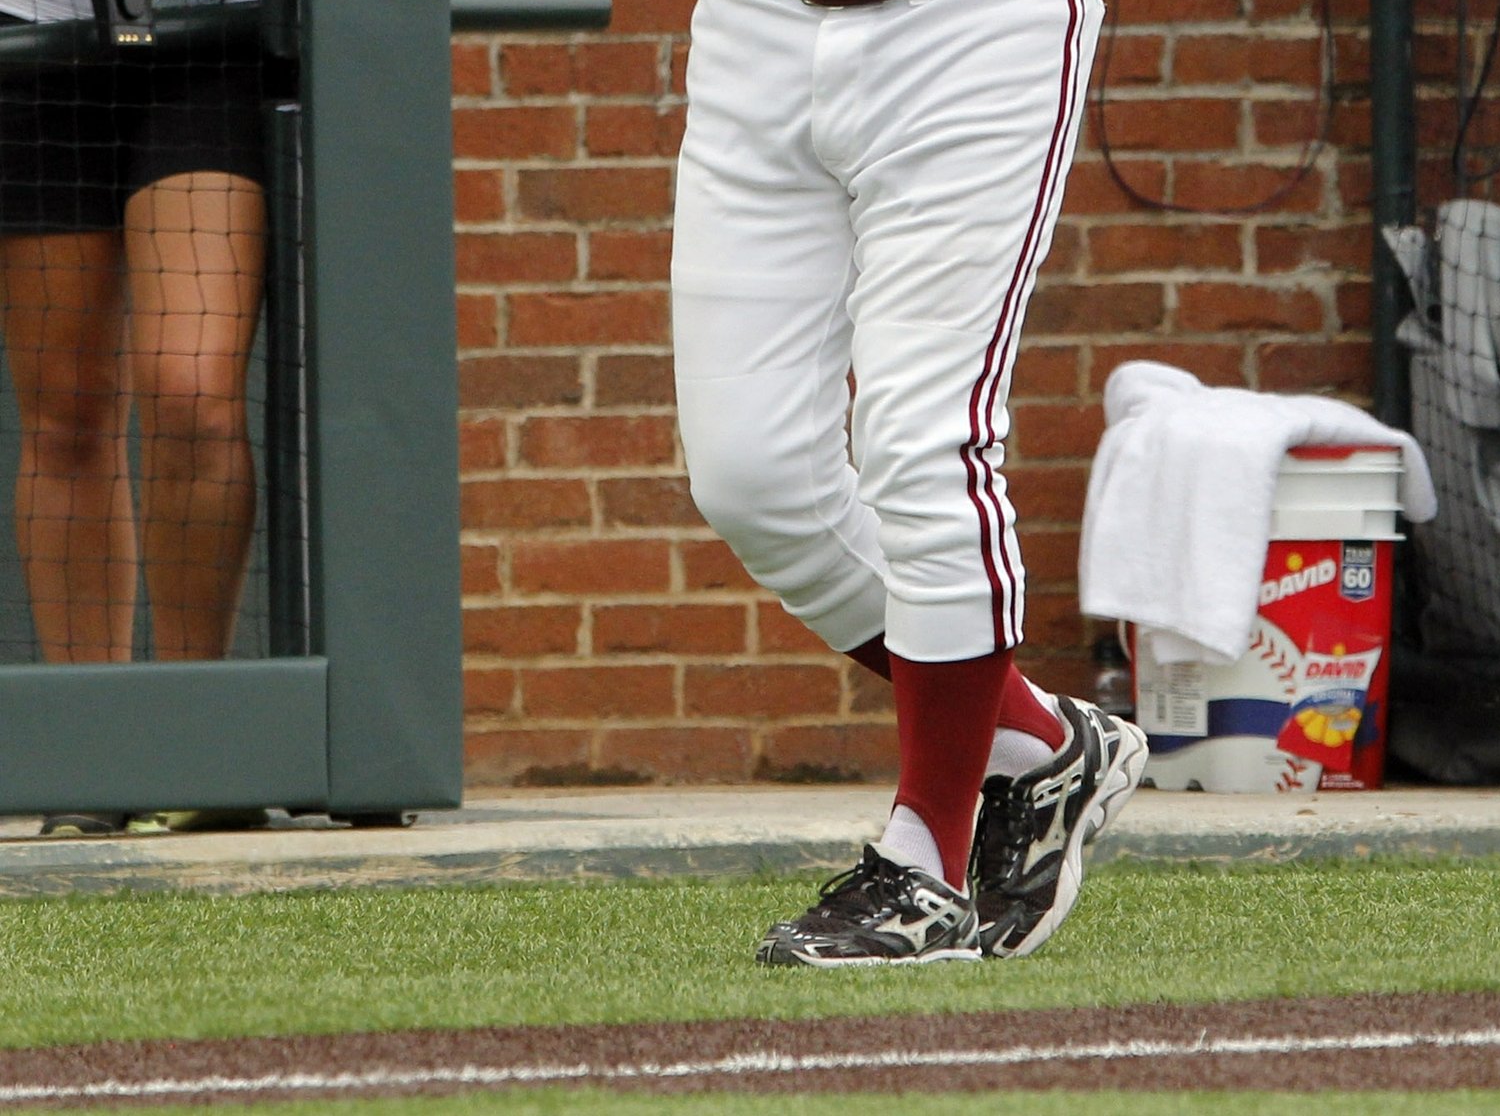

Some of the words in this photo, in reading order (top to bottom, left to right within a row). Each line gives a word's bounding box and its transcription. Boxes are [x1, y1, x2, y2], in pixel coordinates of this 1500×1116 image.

[1259, 557, 1337, 607] DAVID
[1343, 567, 1371, 589] 60
[1306, 660, 1367, 679] DAVID
